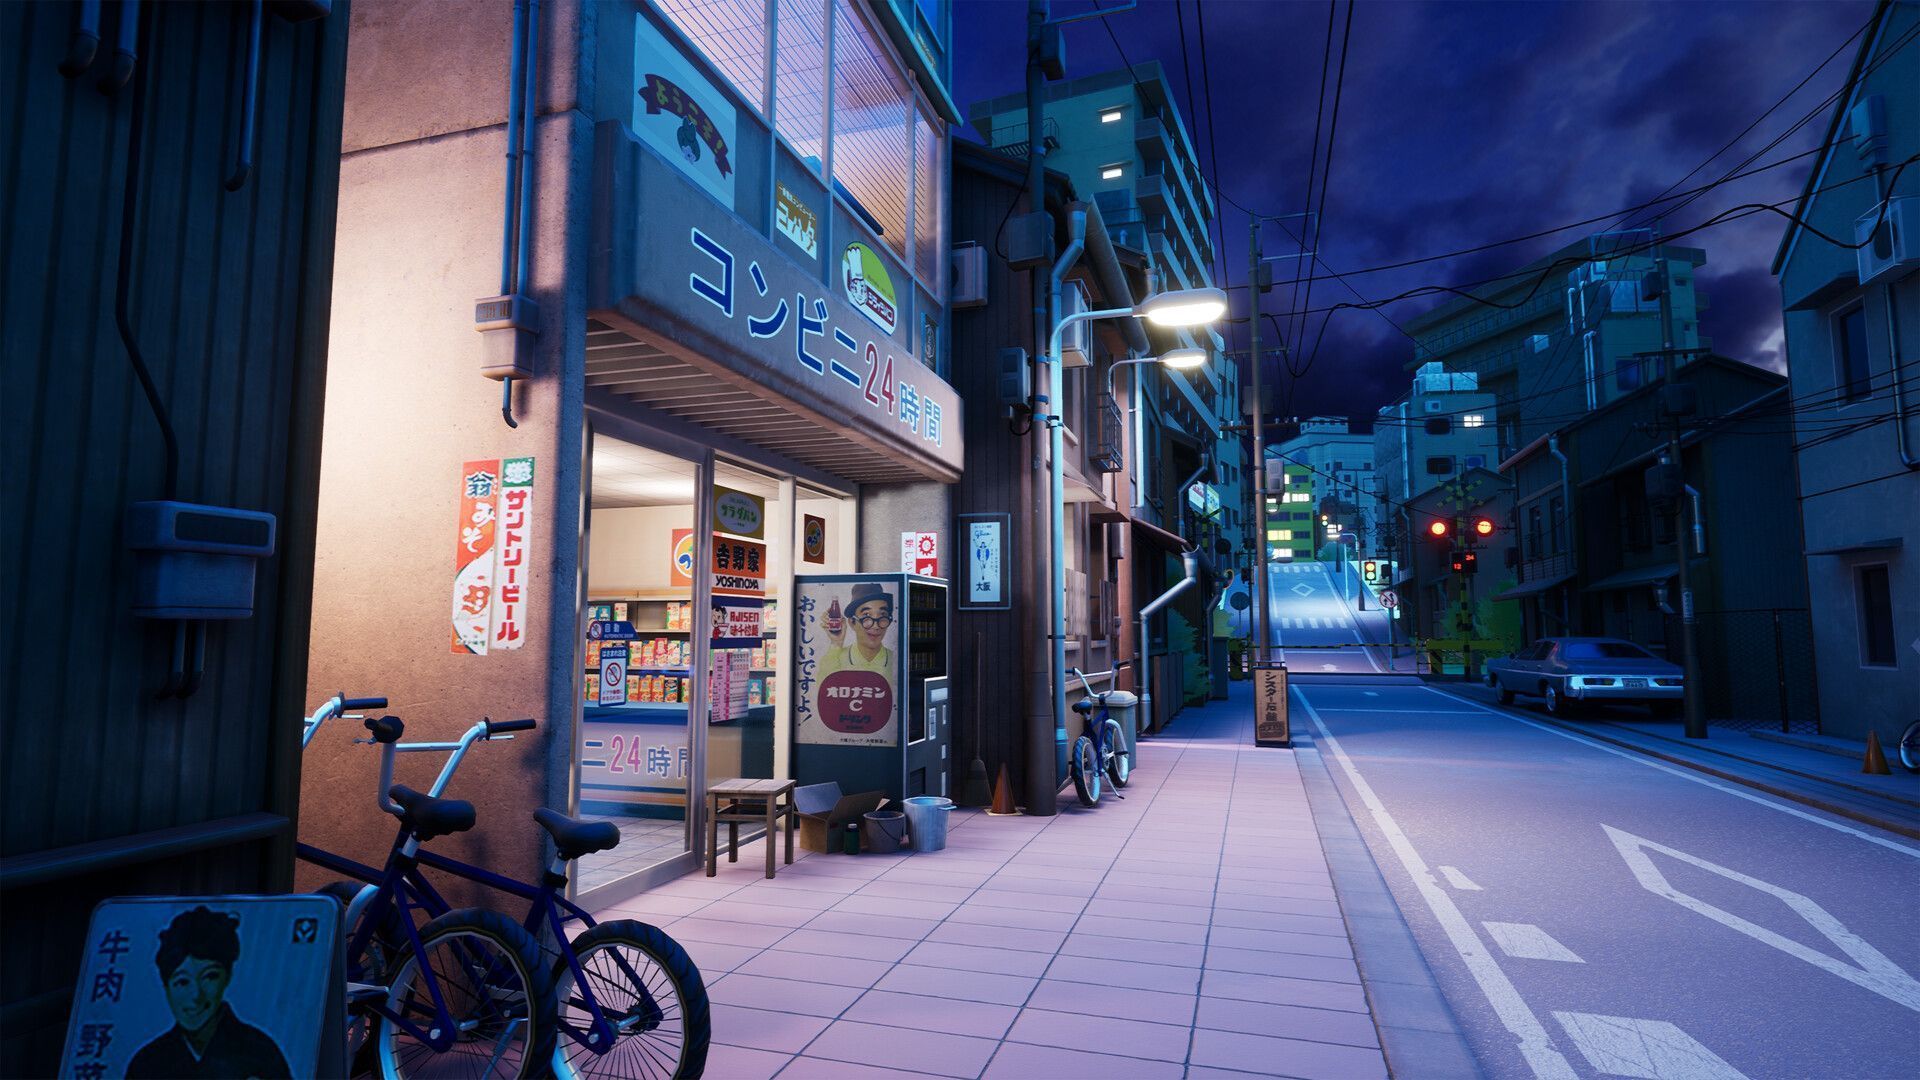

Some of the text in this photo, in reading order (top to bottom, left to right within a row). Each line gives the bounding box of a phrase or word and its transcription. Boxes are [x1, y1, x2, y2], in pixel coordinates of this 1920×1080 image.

[690, 226, 943, 448] コンビニ24時間
[497, 489, 528, 642] サントリービール
[716, 543, 761, 573] 吉野家
[715, 575, 760, 590] YOSHINOYA
[730, 611, 760, 623] AJISEN
[826, 686, 886, 699] オロナミン
[849, 699, 863, 712] C
